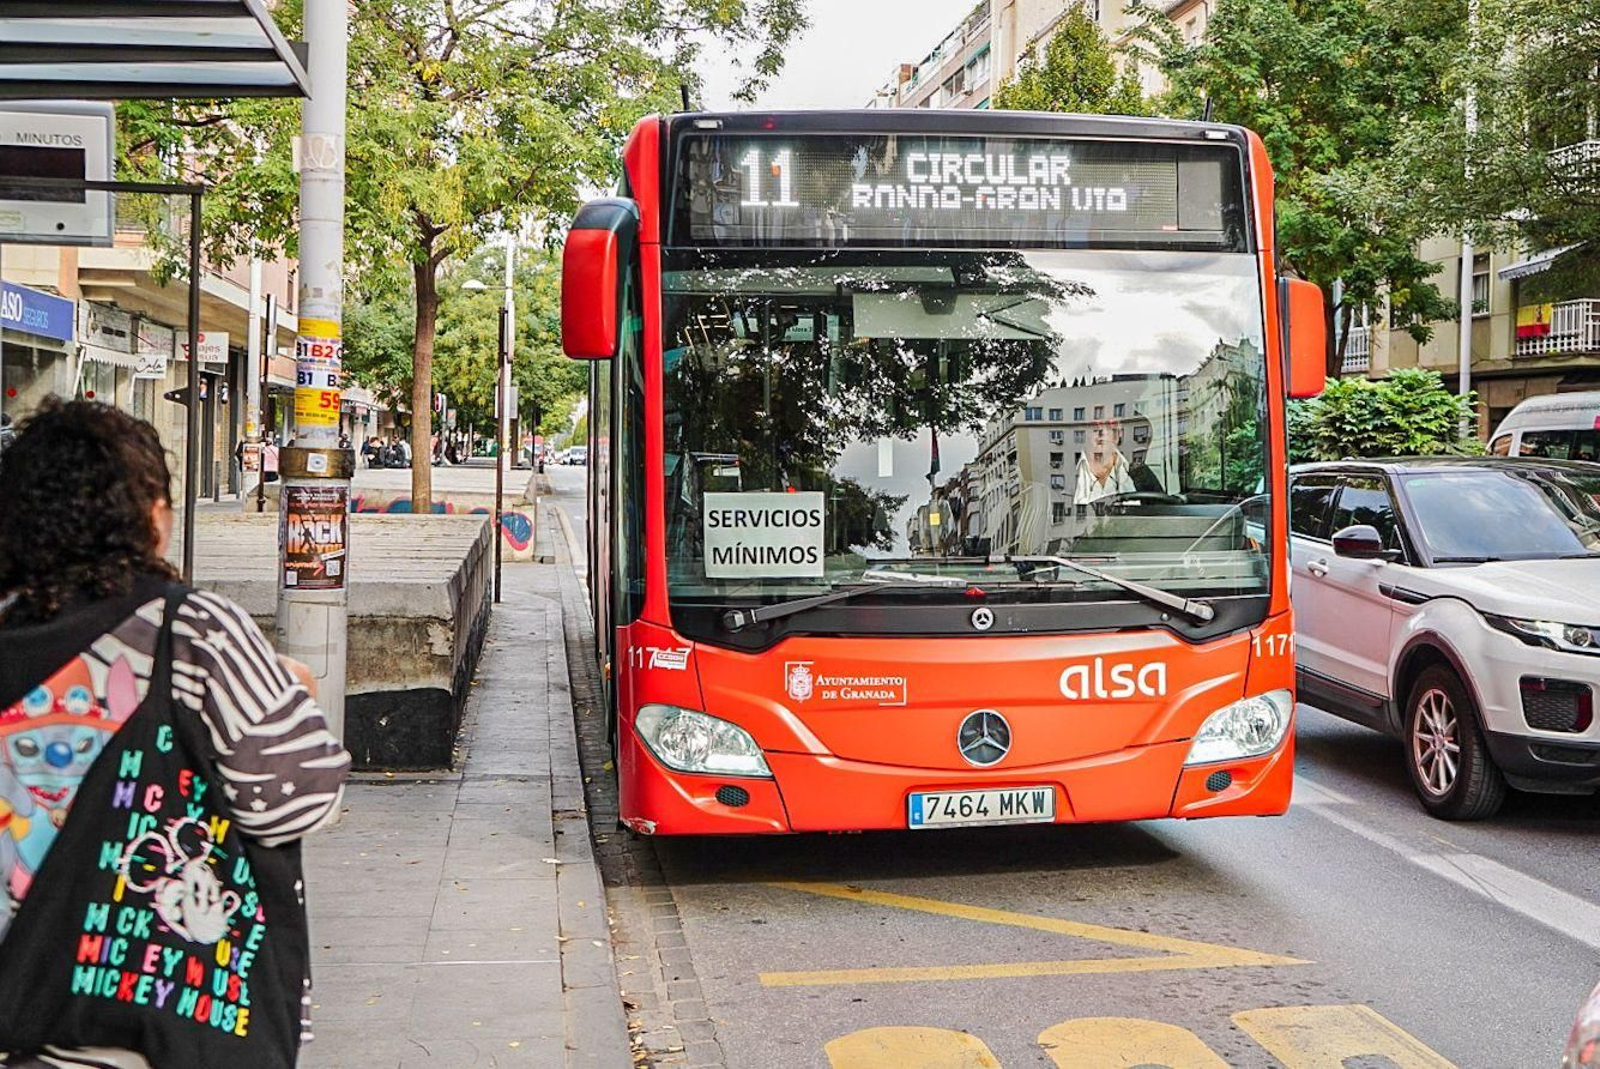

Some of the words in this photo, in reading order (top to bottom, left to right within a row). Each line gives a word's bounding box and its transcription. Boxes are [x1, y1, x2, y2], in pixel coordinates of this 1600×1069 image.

[16, 132, 83, 146] MINUTOS
[741, 150, 799, 207] 11
[907, 153, 1071, 185] CIRCULAR
[198, 345, 221, 354] ajes
[312, 345, 334, 358] B2
[297, 371, 313, 386] B1
[708, 509, 821, 528] SERVICIOS
[712, 541, 818, 565] MÍNIMOS
[1059, 656, 1167, 701] alsa
[926, 793, 989, 820] 7464
[1000, 791, 1045, 816] MKW
[71, 964, 175, 1009] MICKEY
[175, 986, 250, 1037] MOUSE
